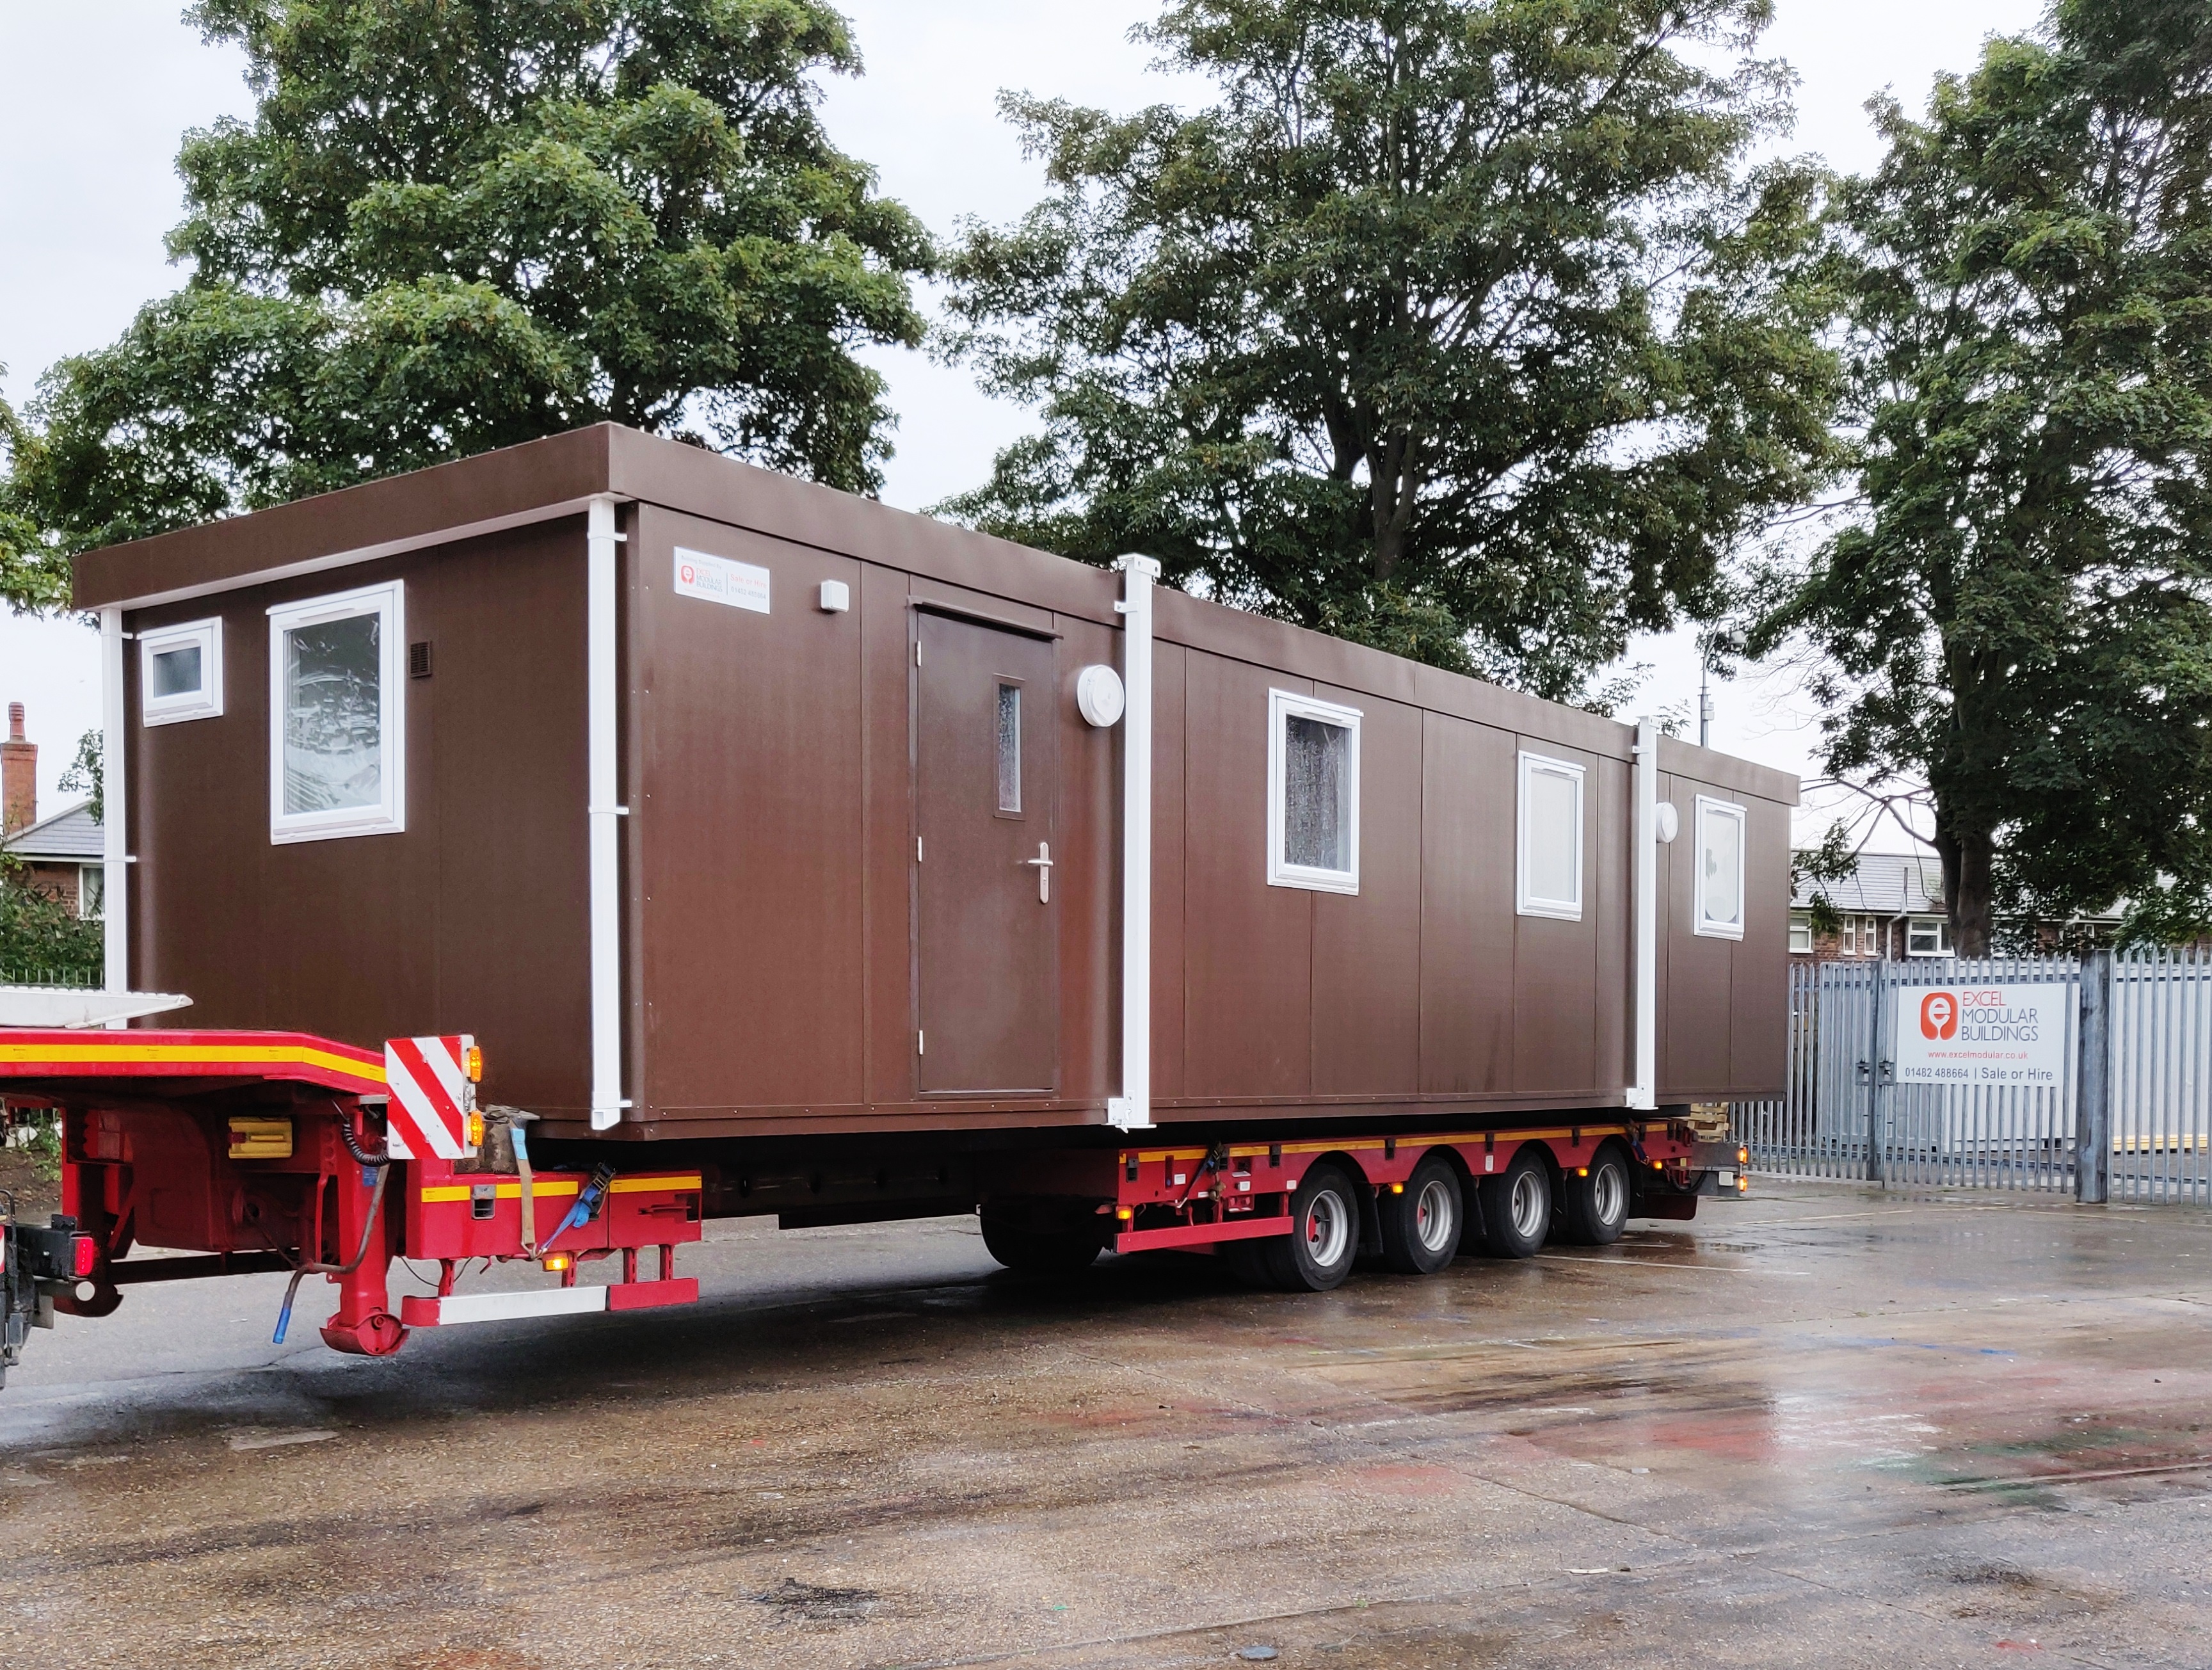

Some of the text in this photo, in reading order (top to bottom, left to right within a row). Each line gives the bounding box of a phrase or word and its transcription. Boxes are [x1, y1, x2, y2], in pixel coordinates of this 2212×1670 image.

[698, 559, 716, 568] Spled
[696, 568, 711, 577] EXCEL
[696, 575, 722, 586] MODULAR
[730, 574, 744, 583] Sale
[754, 579, 767, 589] Hire
[696, 581, 723, 593] BUILDINGS
[1962, 991, 2007, 1006] EXCEL
[1962, 1008, 2039, 1024] MODULAR
[1962, 1025, 2039, 1041] BUILDINGS
[1928, 1051, 2028, 1059] www.excelmodular.co.uk
[1905, 1067, 2053, 1080] 01482 488664 Sale or Hire
